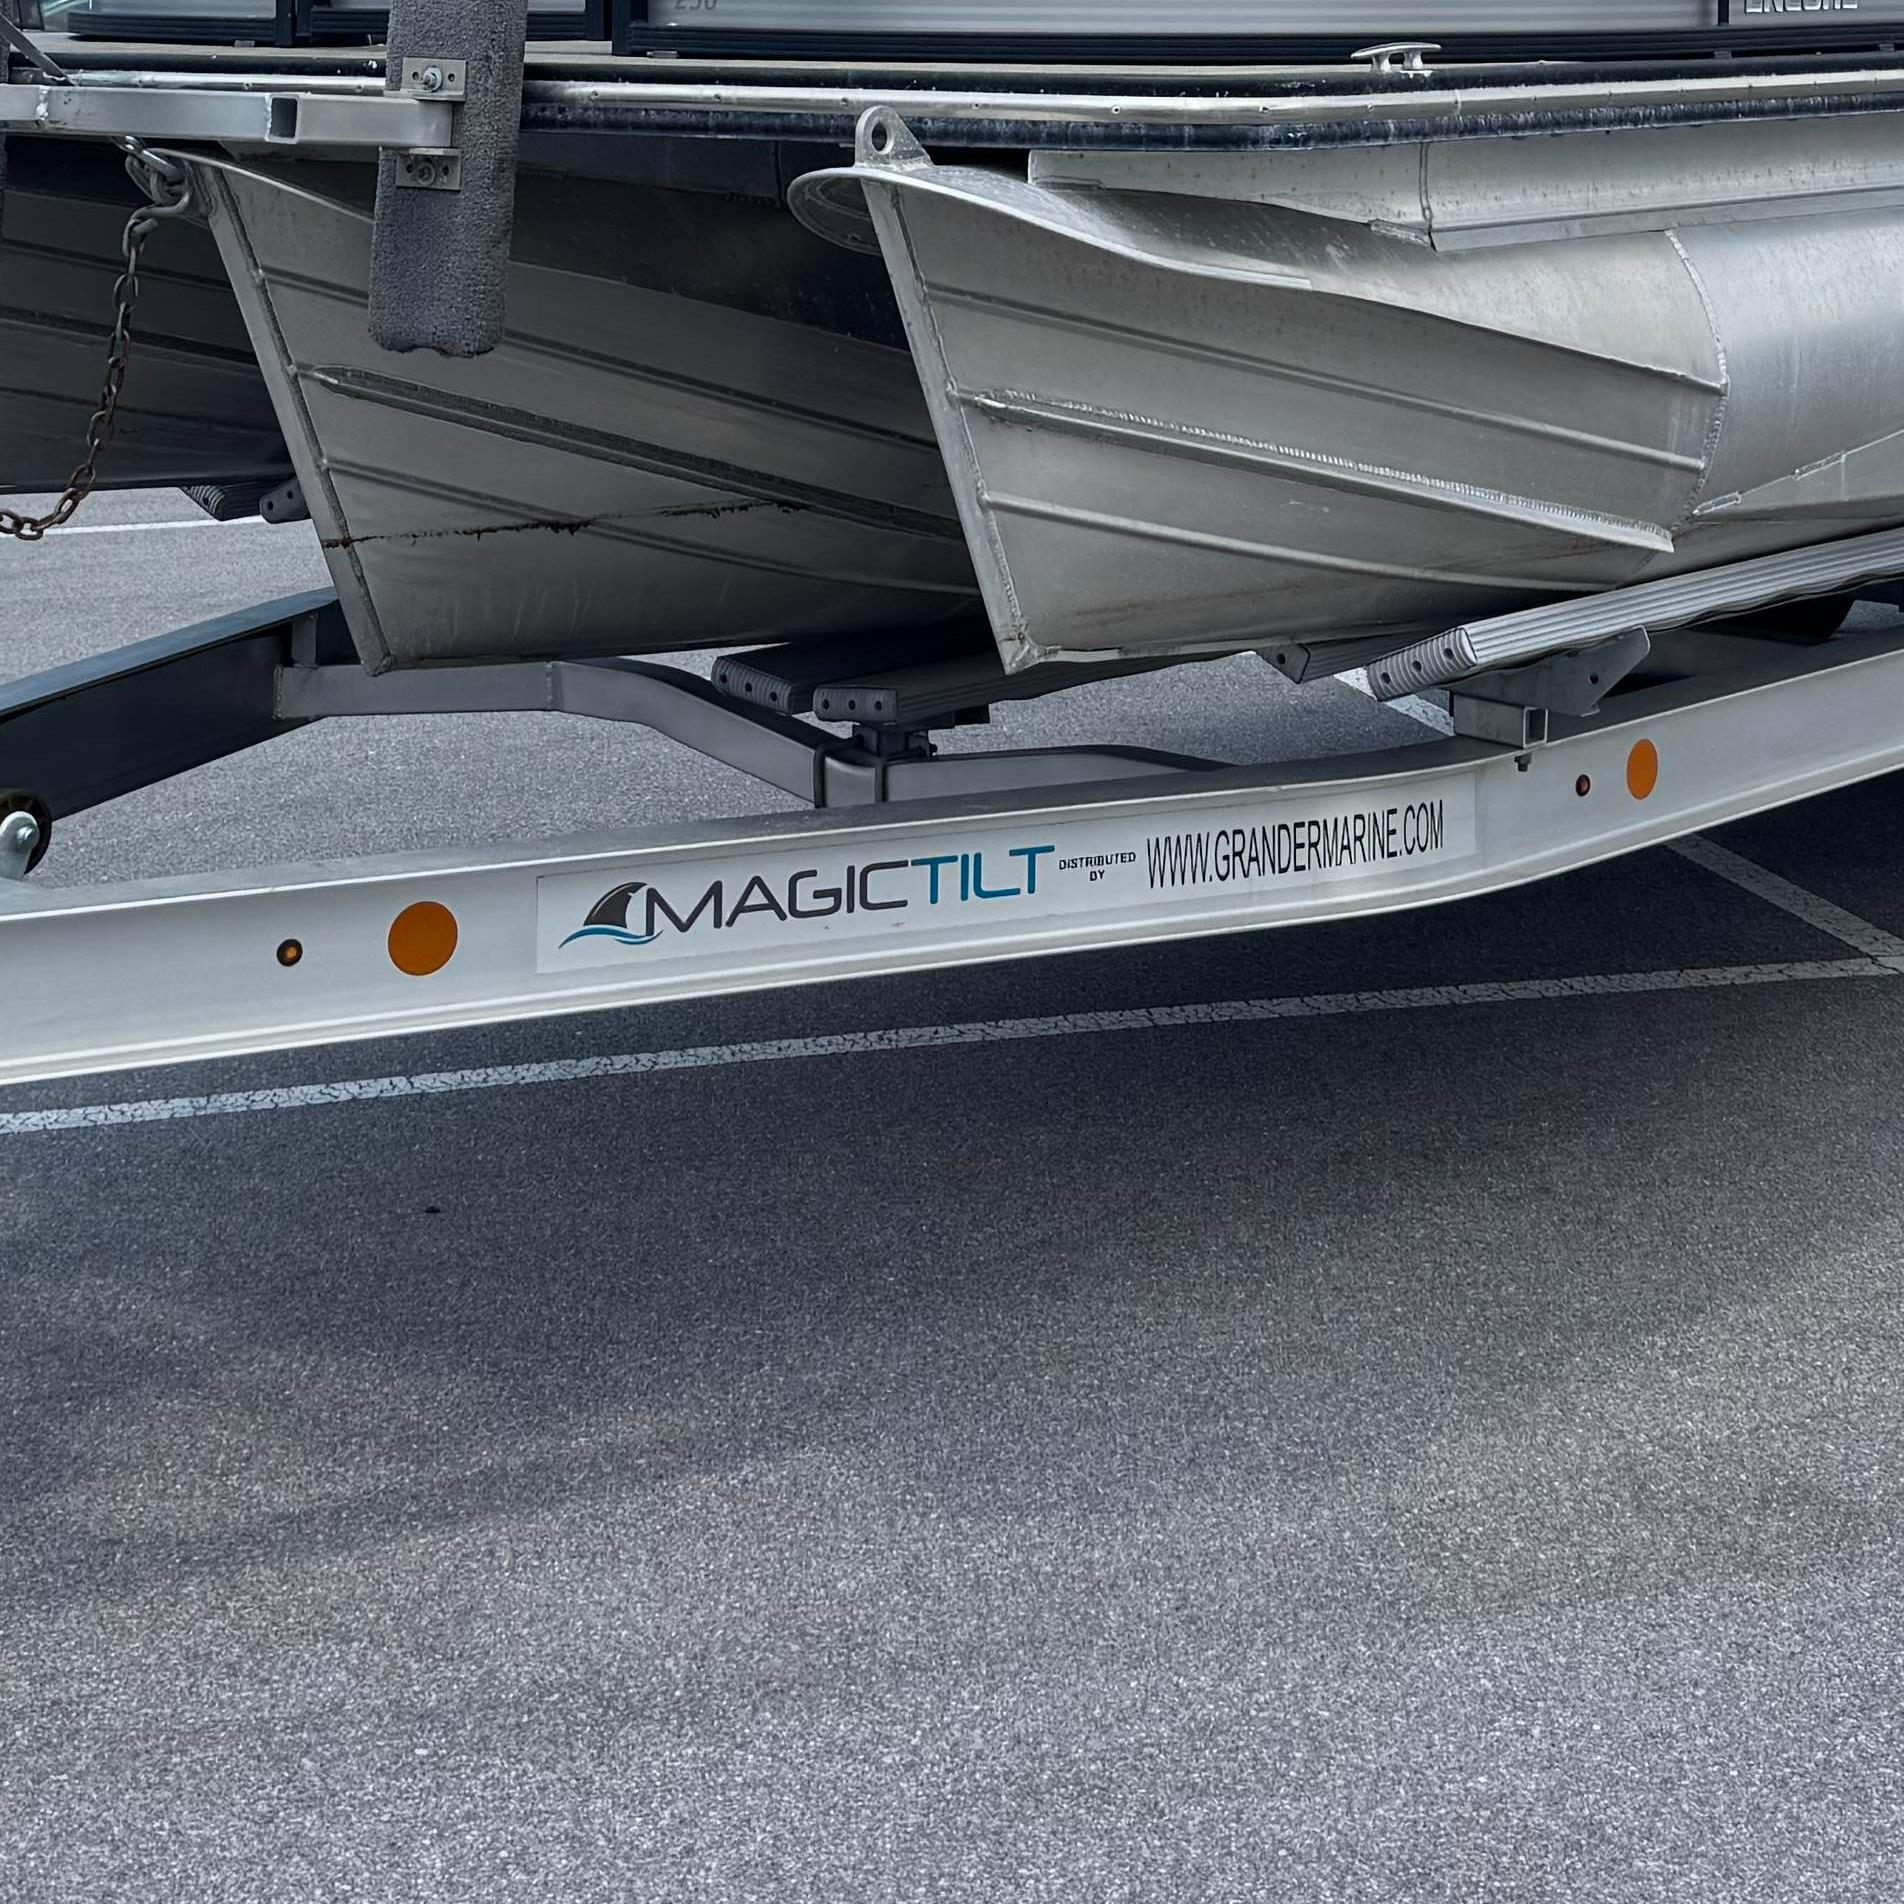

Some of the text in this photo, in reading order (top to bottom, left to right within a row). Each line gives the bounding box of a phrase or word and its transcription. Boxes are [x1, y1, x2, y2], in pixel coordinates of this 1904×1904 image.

[1058, 851, 1137, 871] DISTRIBUTED
[1146, 798, 1444, 890] WWW.GRANDERMARINE.COM
[644, 844, 1056, 937] MAGICTILT
[1089, 870, 1106, 882] BY
